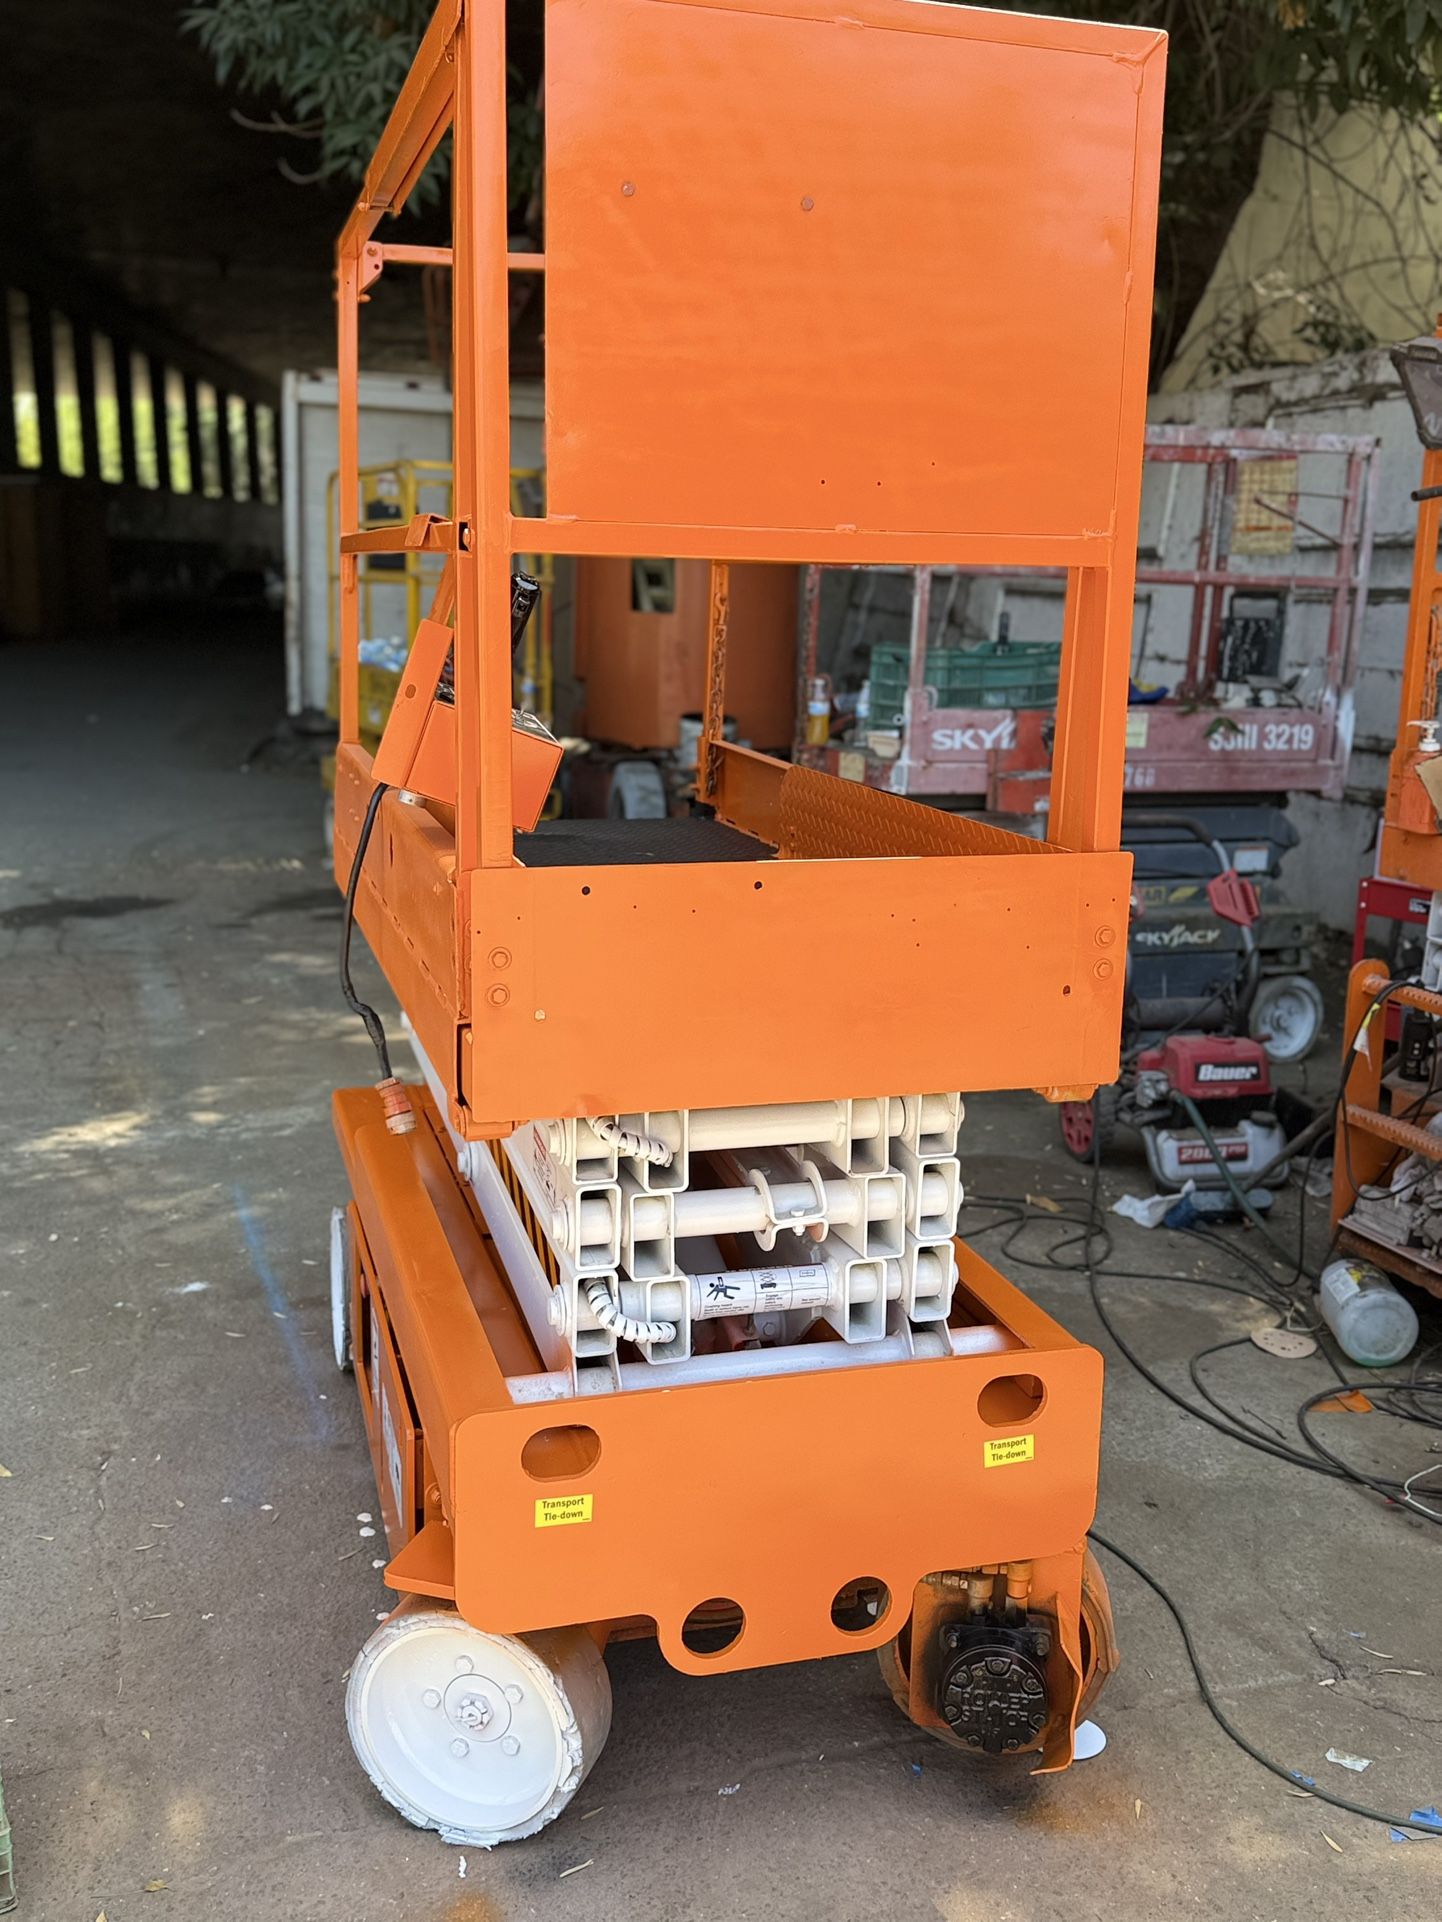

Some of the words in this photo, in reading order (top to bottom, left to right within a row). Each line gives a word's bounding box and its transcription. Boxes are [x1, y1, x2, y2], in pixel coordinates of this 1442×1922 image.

[1263, 723, 1315, 752] 3219
[1198, 1064, 1258, 1081] Bauer
[989, 1437, 1027, 1450] Transport
[991, 1450, 1027, 1462] Tie-down
[541, 1496, 585, 1509] Transport
[543, 1510, 584, 1521] Tie-down
